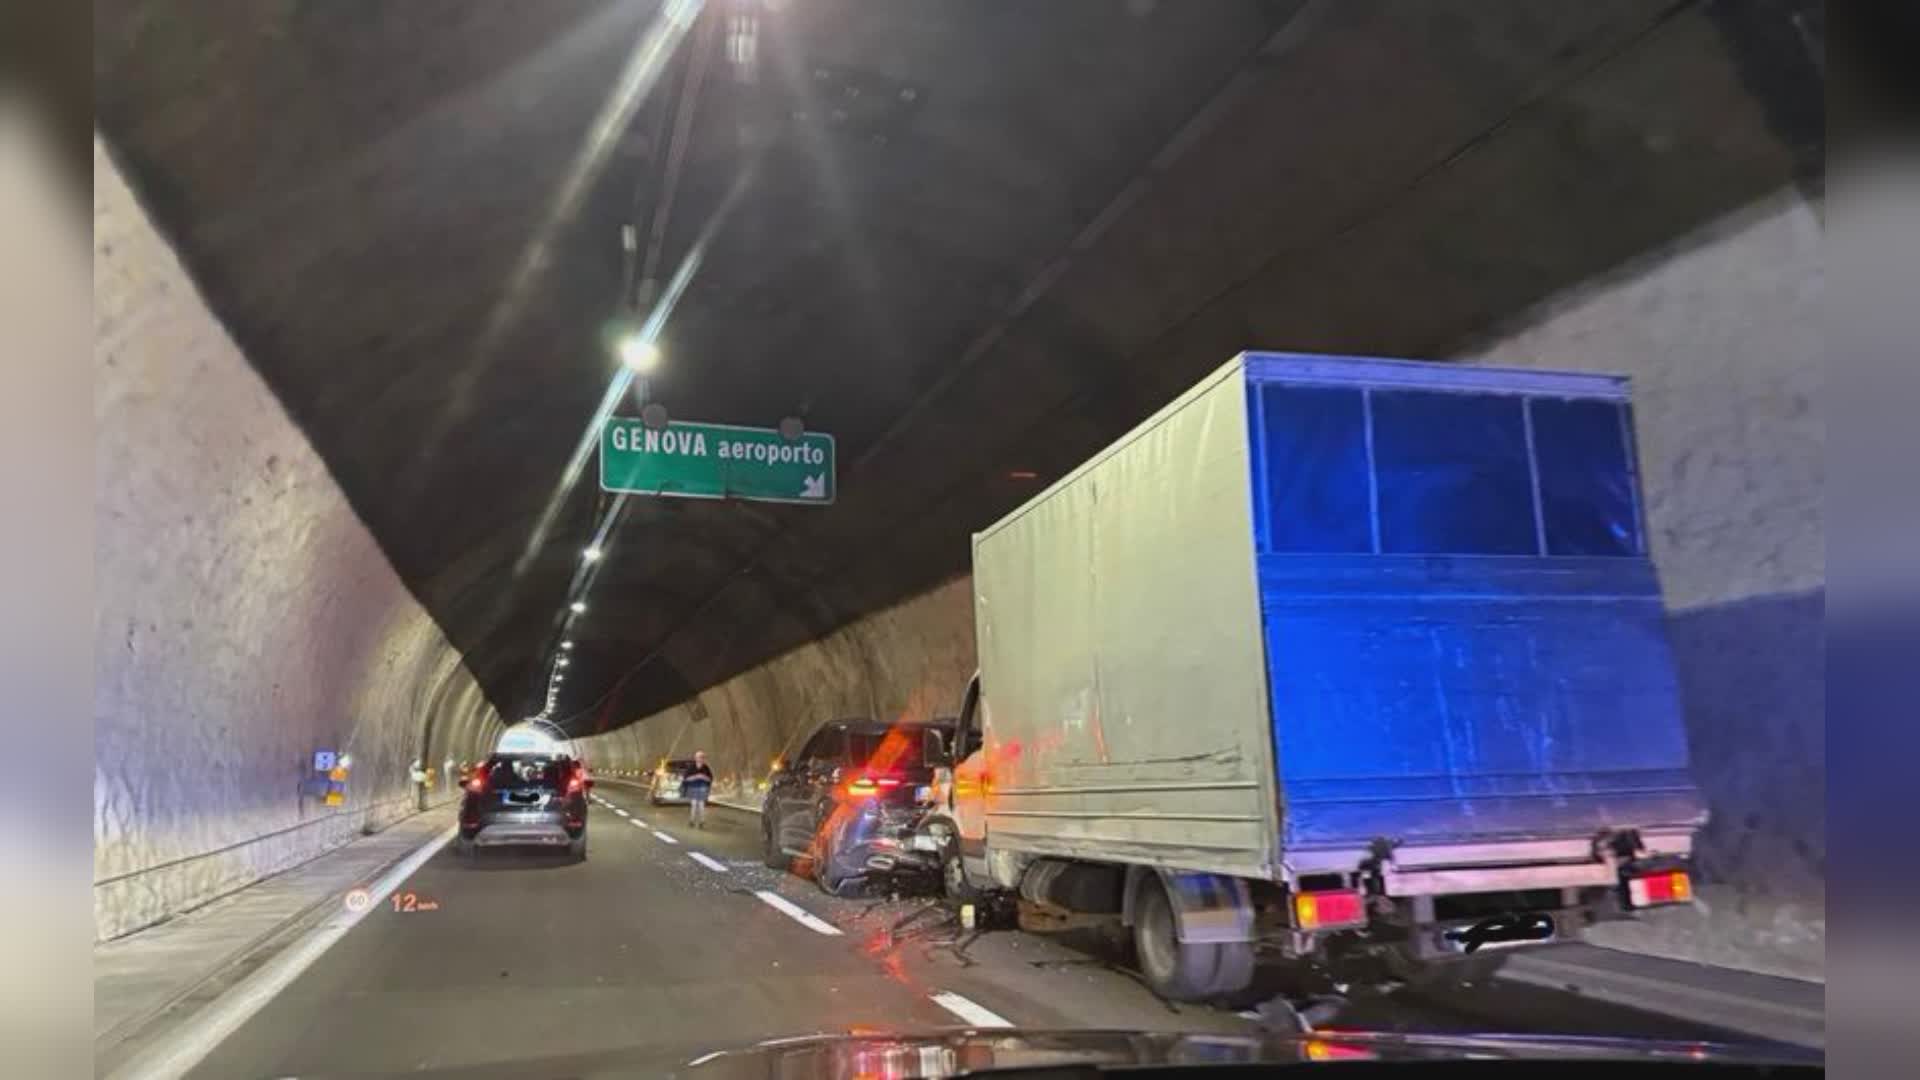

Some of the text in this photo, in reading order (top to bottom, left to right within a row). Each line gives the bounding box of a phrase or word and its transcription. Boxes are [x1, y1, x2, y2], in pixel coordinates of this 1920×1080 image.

[612, 426, 825, 466] GENOVA aeroporto
[391, 893, 417, 912] 12
